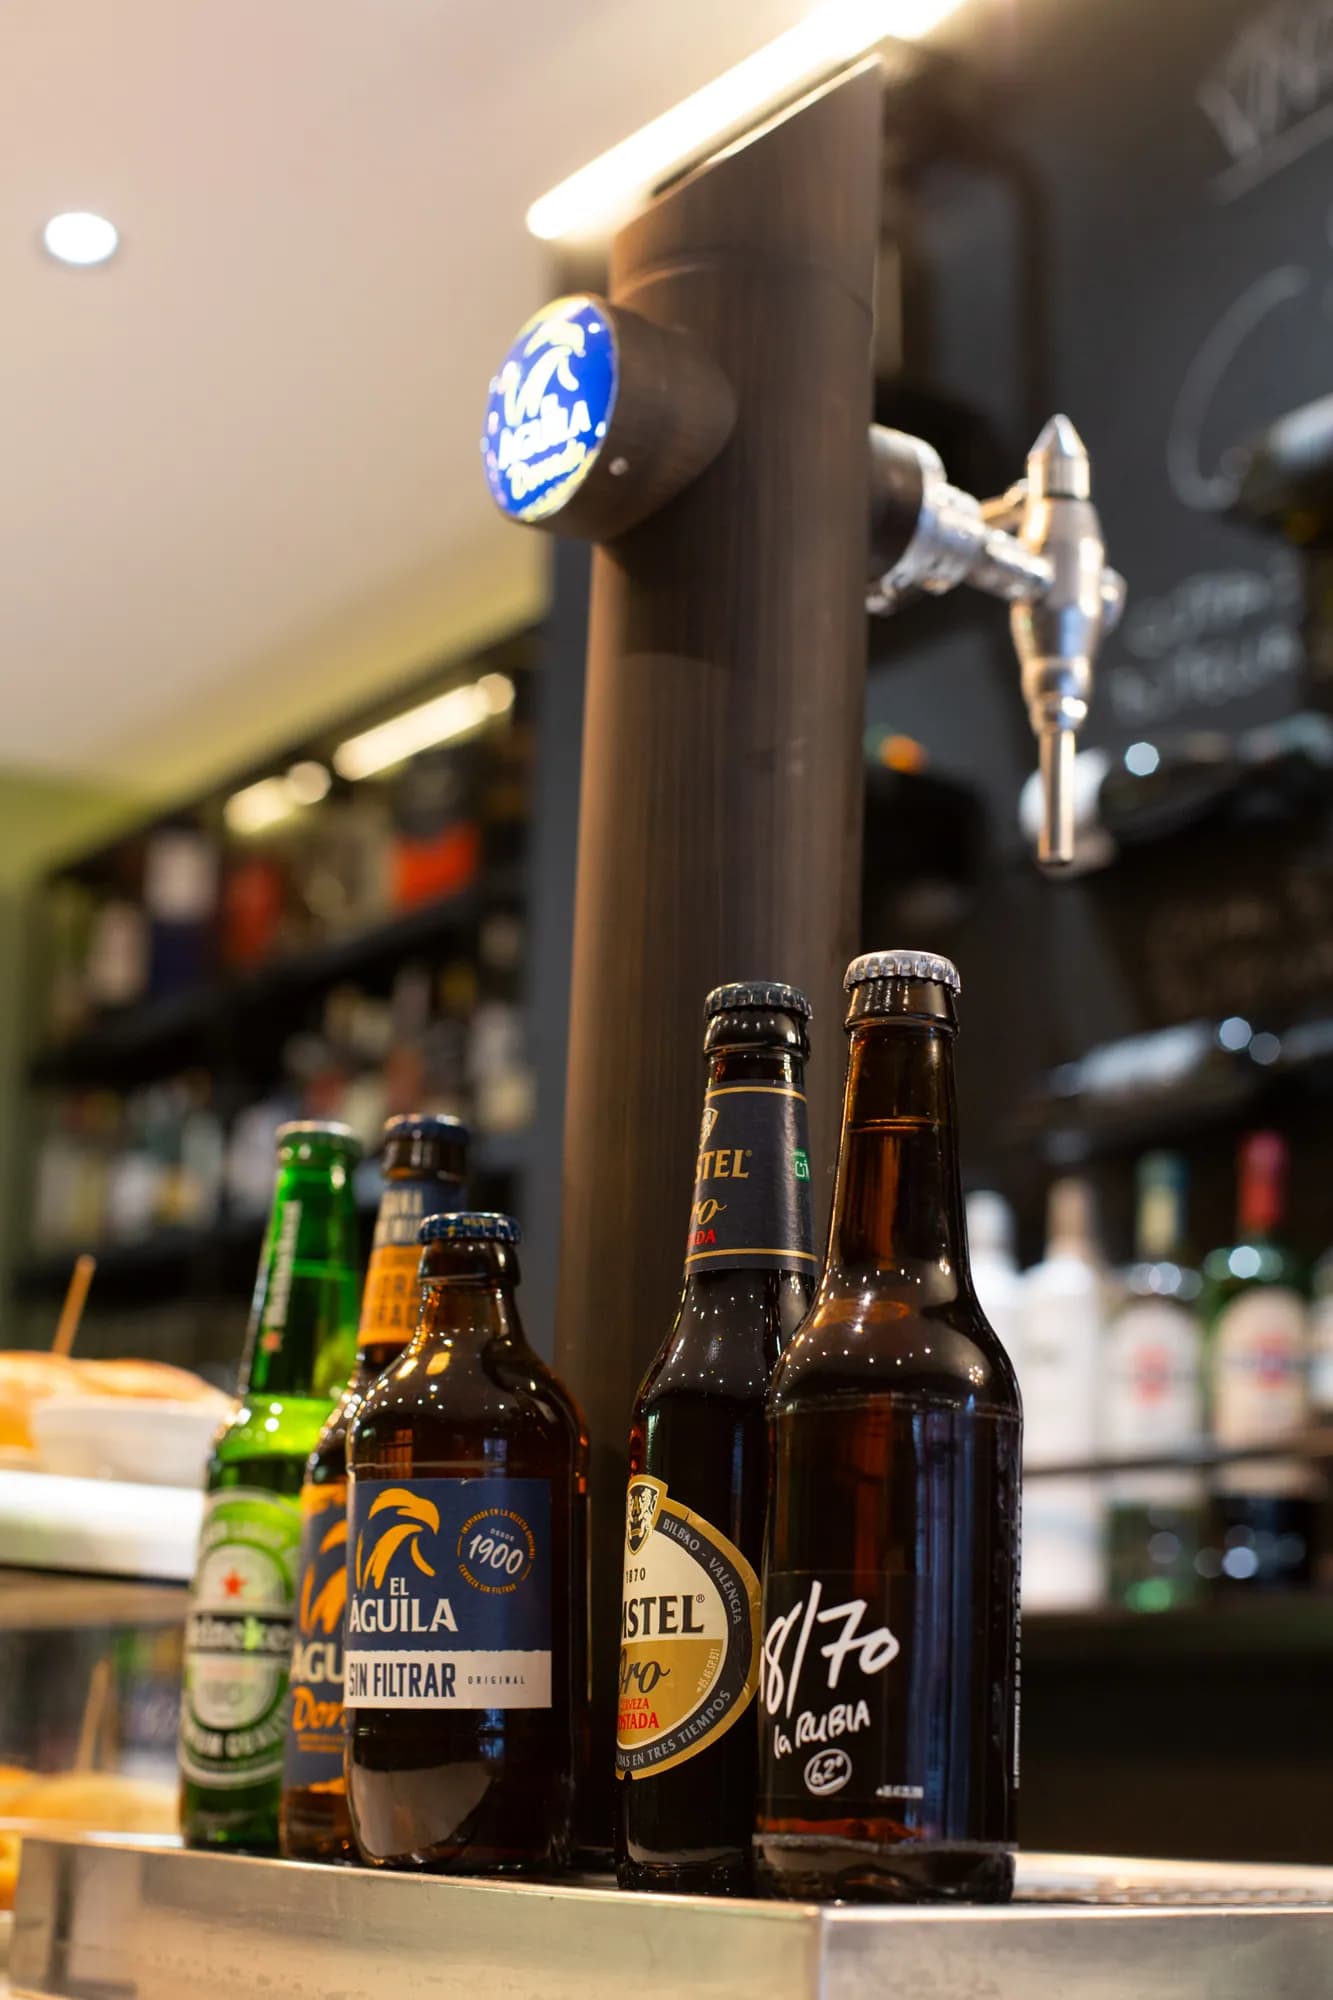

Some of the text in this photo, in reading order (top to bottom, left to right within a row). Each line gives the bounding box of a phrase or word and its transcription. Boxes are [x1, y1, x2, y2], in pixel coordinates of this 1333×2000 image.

[696, 1149, 751, 1184] TEL
[469, 1533, 524, 1575] 1900
[662, 1518, 743, 1625] BILBAO VALENCIA
[390, 1576, 410, 1596] EL
[349, 1662, 527, 1698] SIN FILTRAR ORIGINAL
[632, 1752, 645, 1767] EN
[648, 1738, 676, 1761] TRES
[677, 1690, 731, 1744] TIEMPOS
[774, 1698, 871, 1760] la RUBIA
